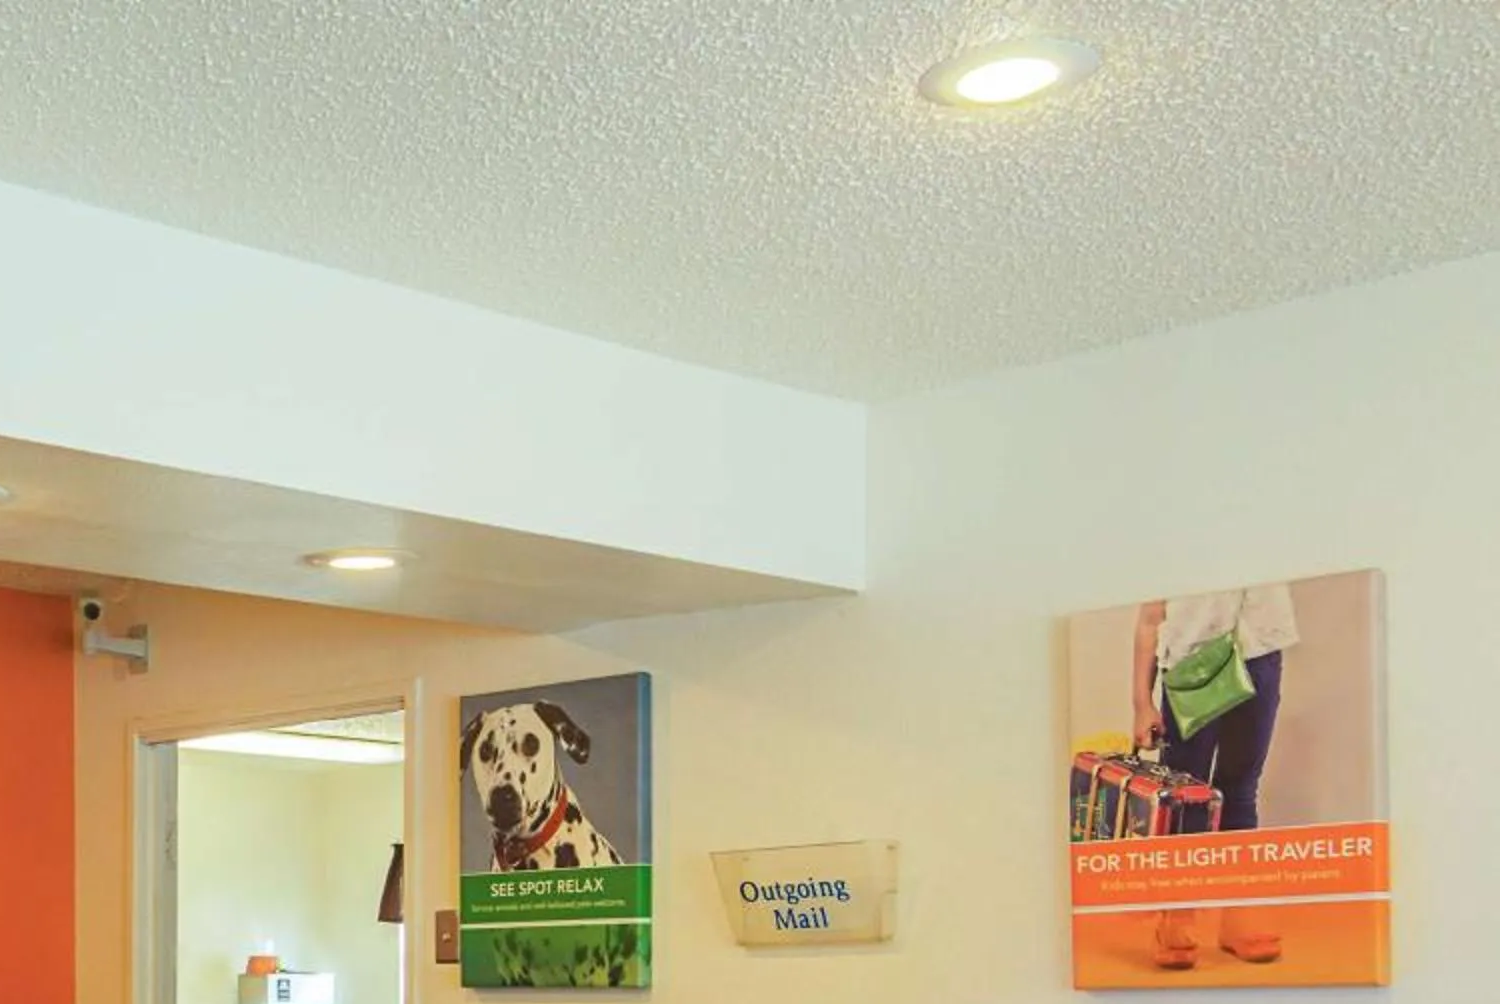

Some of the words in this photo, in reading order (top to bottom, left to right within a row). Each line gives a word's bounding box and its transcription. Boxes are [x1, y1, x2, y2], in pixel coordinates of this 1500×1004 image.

[1077, 855, 1121, 874] FOR
[1126, 851, 1169, 870] THE
[1174, 846, 1242, 867] LIGHT
[1248, 836, 1372, 862] TRAVELER
[490, 882, 515, 898] SEE
[519, 880, 553, 896] SPOT
[557, 877, 605, 895] RELAX
[739, 877, 851, 905] Outgoing
[773, 906, 829, 930] Mail
